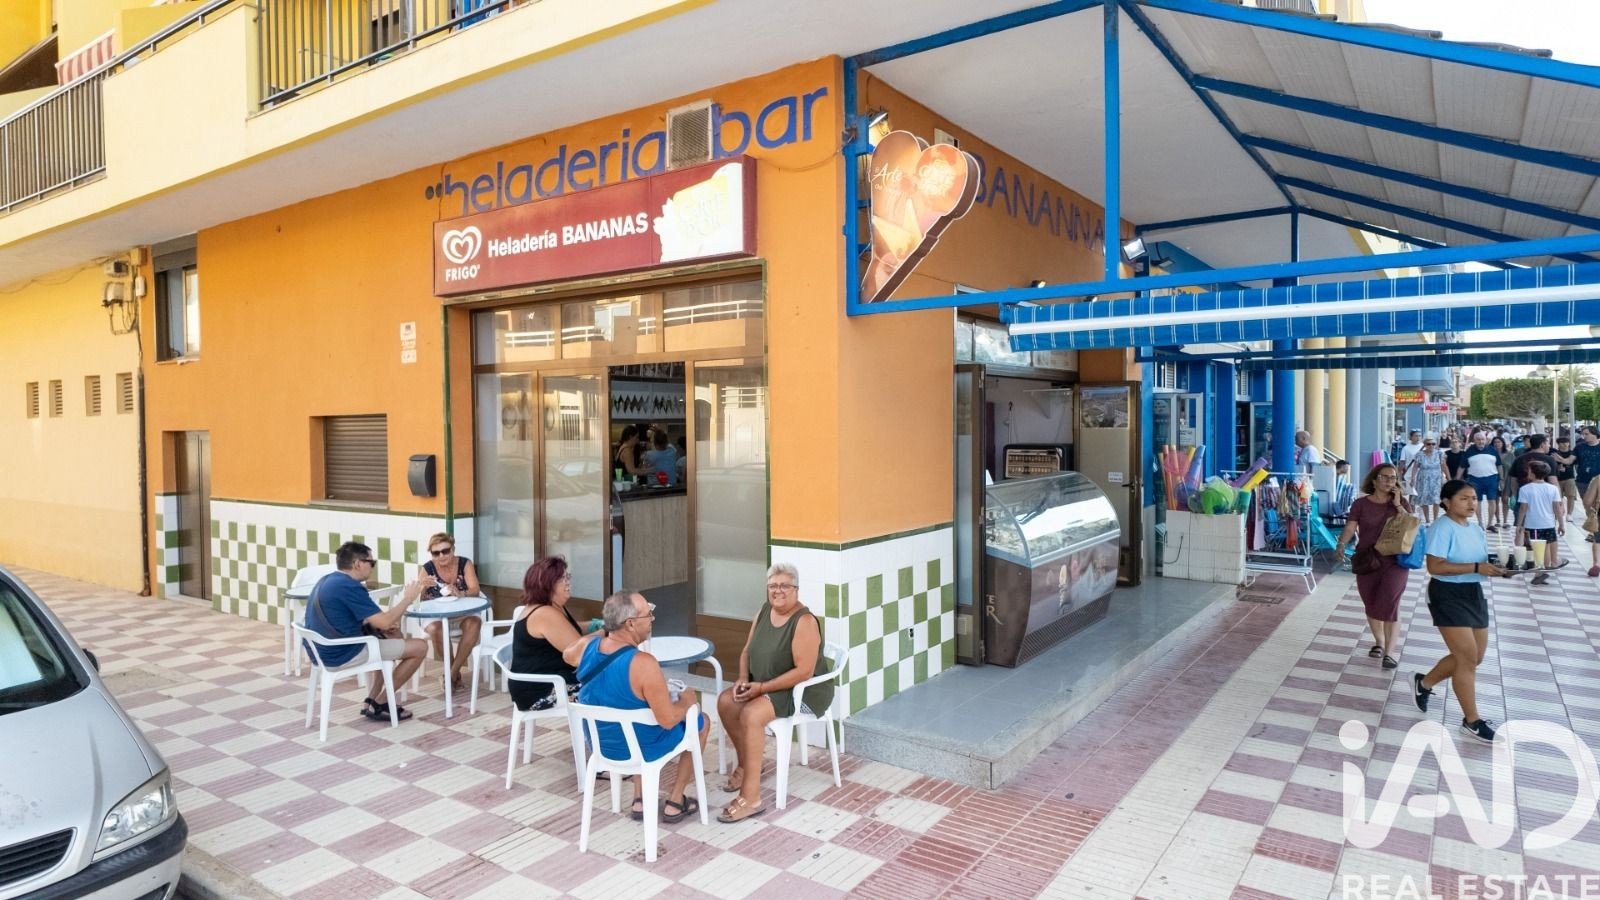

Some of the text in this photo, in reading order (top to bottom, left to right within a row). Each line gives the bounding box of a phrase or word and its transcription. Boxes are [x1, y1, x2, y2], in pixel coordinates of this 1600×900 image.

[711, 87, 828, 160] bar
[487, 229, 558, 258] Heladería
[562, 212, 649, 246] BANANAS
[445, 265, 478, 282] FRIGO
